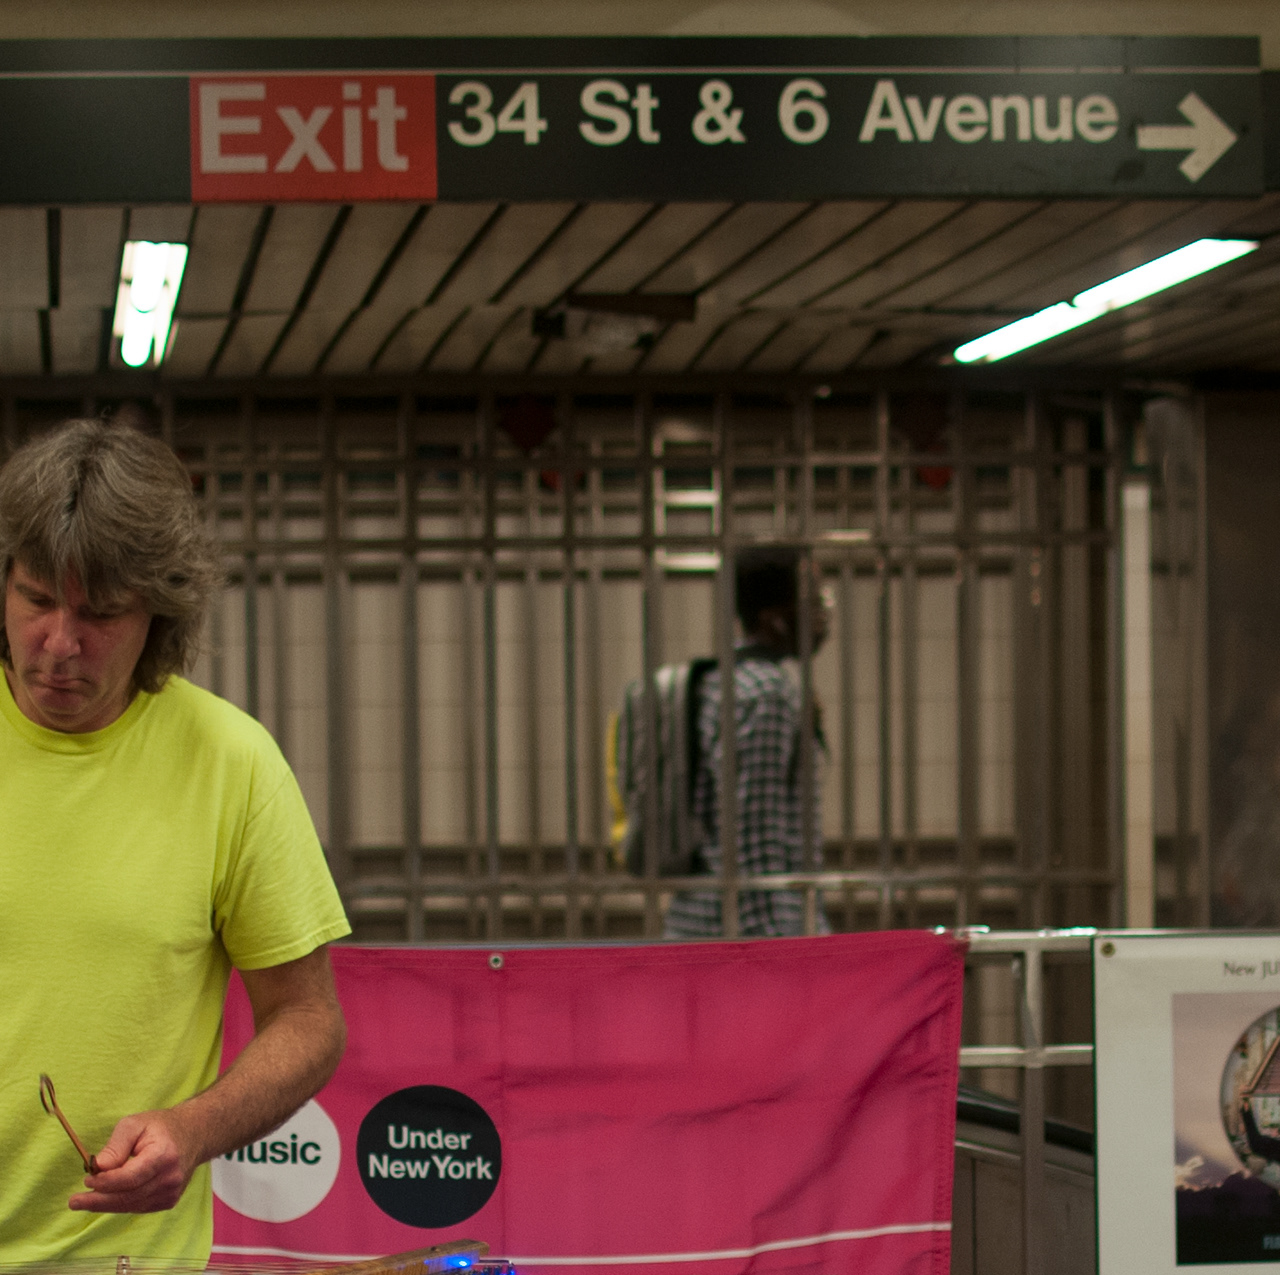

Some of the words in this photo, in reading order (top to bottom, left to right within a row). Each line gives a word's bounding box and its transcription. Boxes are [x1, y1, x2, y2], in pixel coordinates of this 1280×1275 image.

[198, 82, 410, 173] Exit
[448, 82, 547, 147] 34
[578, 80, 661, 145] St
[691, 82, 745, 145] &
[777, 80, 830, 144] 6
[860, 80, 1118, 144] Avenue
[1224, 960, 1256, 976] New
[388, 1124, 471, 1151] Under
[368, 1155, 430, 1181] New
[433, 1155, 492, 1181] York
